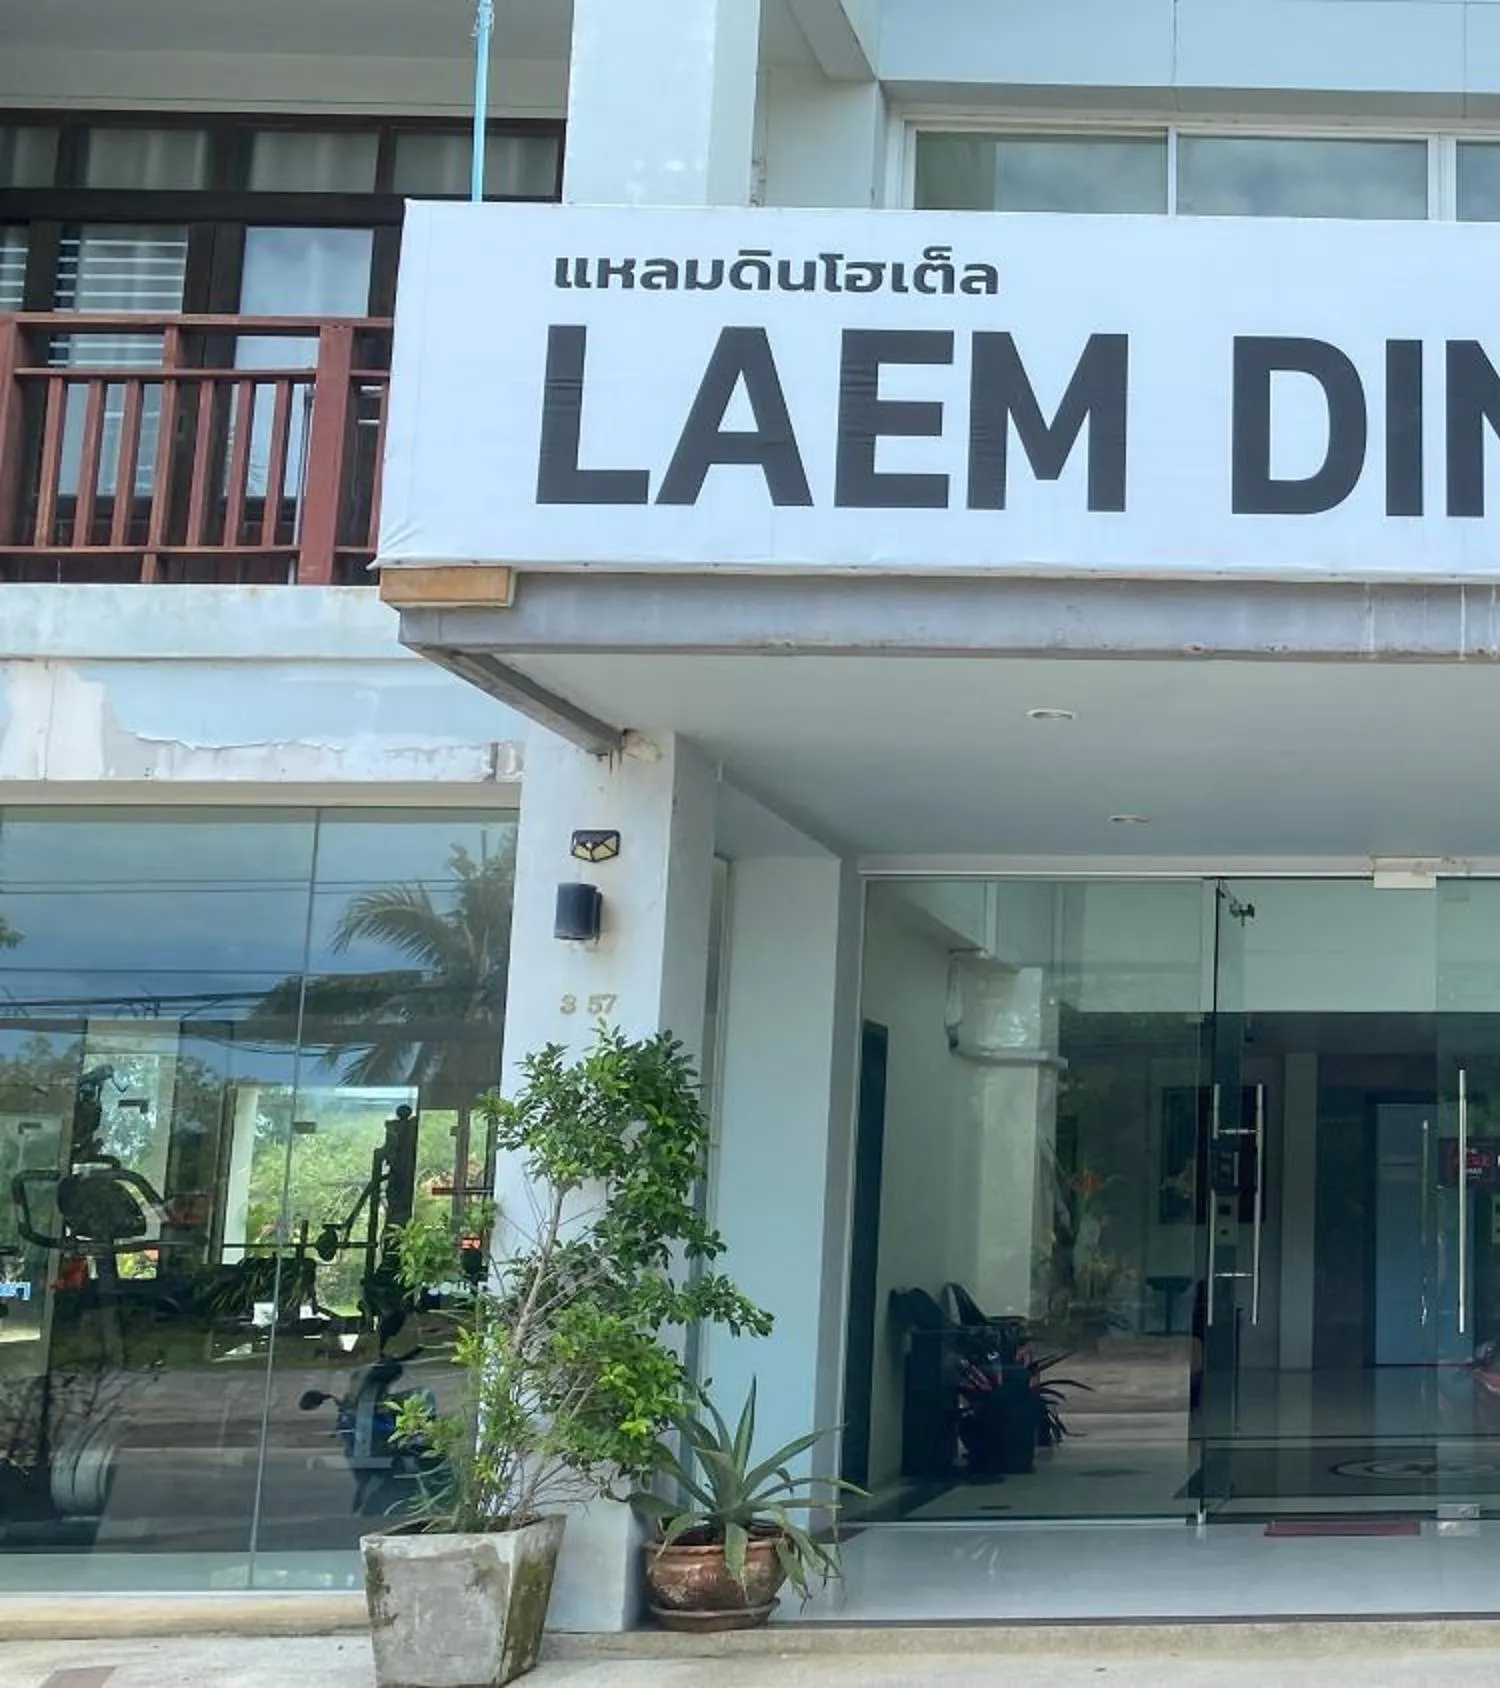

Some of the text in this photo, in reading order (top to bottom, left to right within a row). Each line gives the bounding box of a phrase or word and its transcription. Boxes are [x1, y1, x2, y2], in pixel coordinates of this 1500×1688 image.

[554, 245, 999, 295] แหลมดินโฮเต็ล
[535, 325, 1128, 512] LAEM
